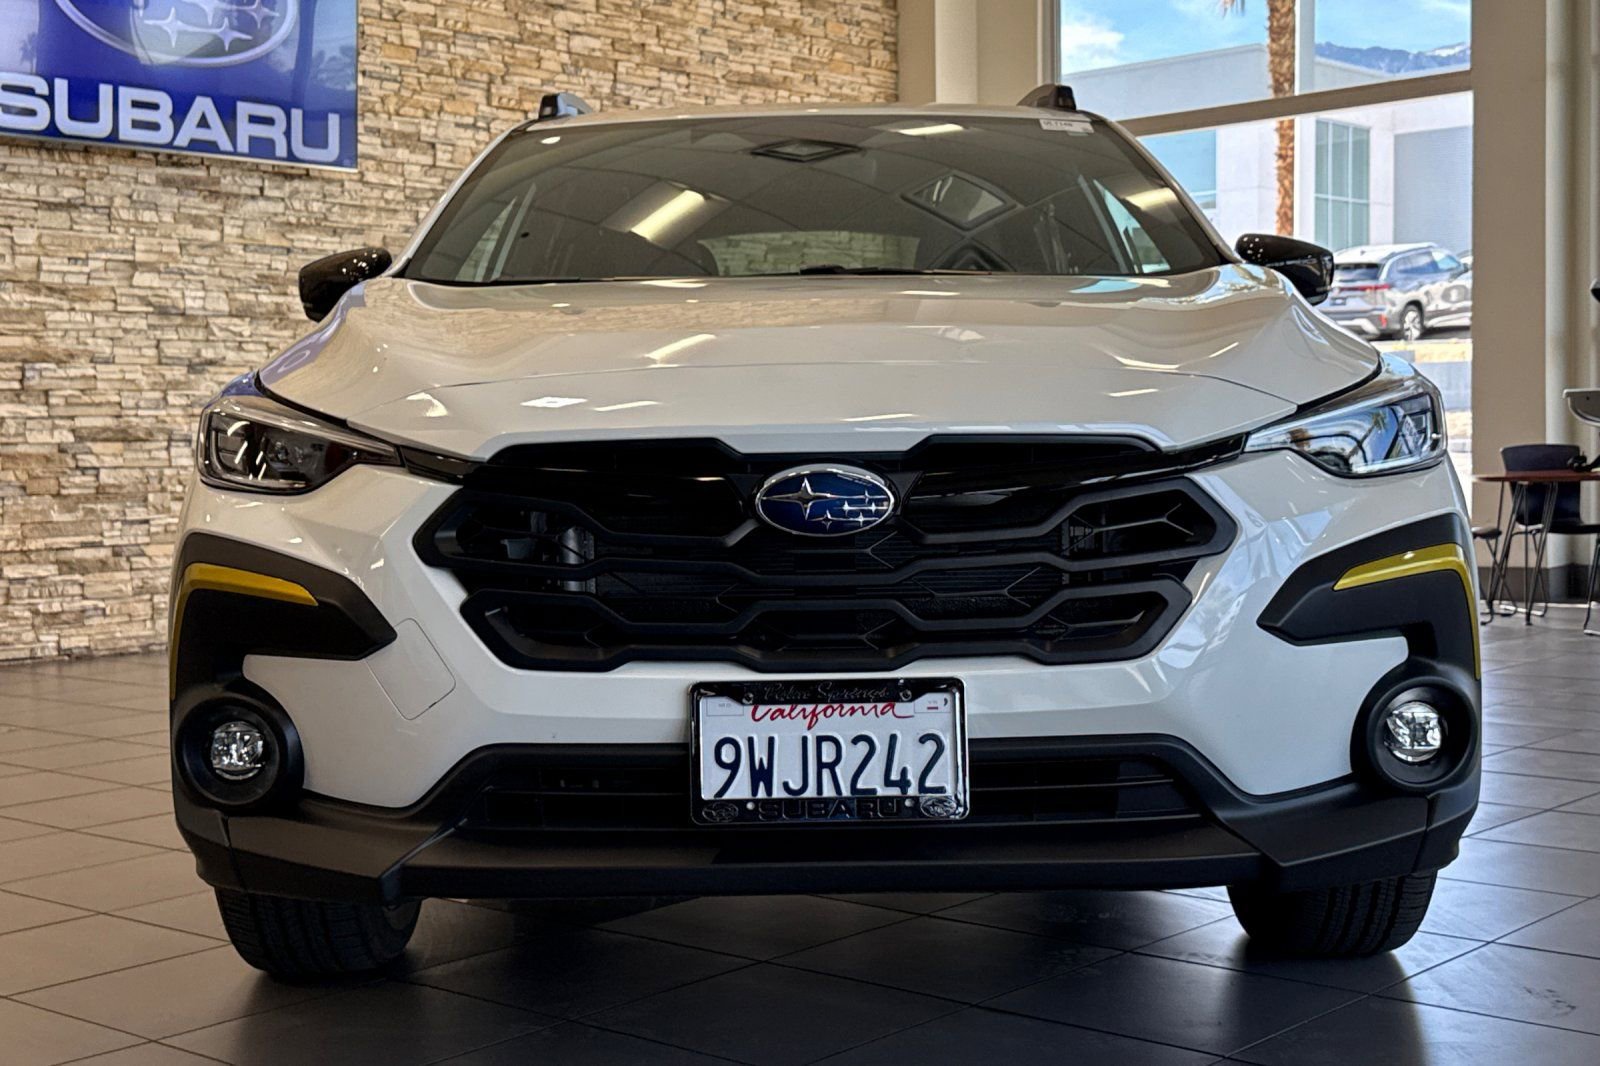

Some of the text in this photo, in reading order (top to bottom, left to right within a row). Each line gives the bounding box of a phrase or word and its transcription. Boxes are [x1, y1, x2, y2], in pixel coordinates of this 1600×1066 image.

[0, 71, 341, 163] SUBARU
[751, 702, 915, 730] California
[713, 732, 947, 799] 9WJR242
[757, 800, 898, 821] SUBARU
